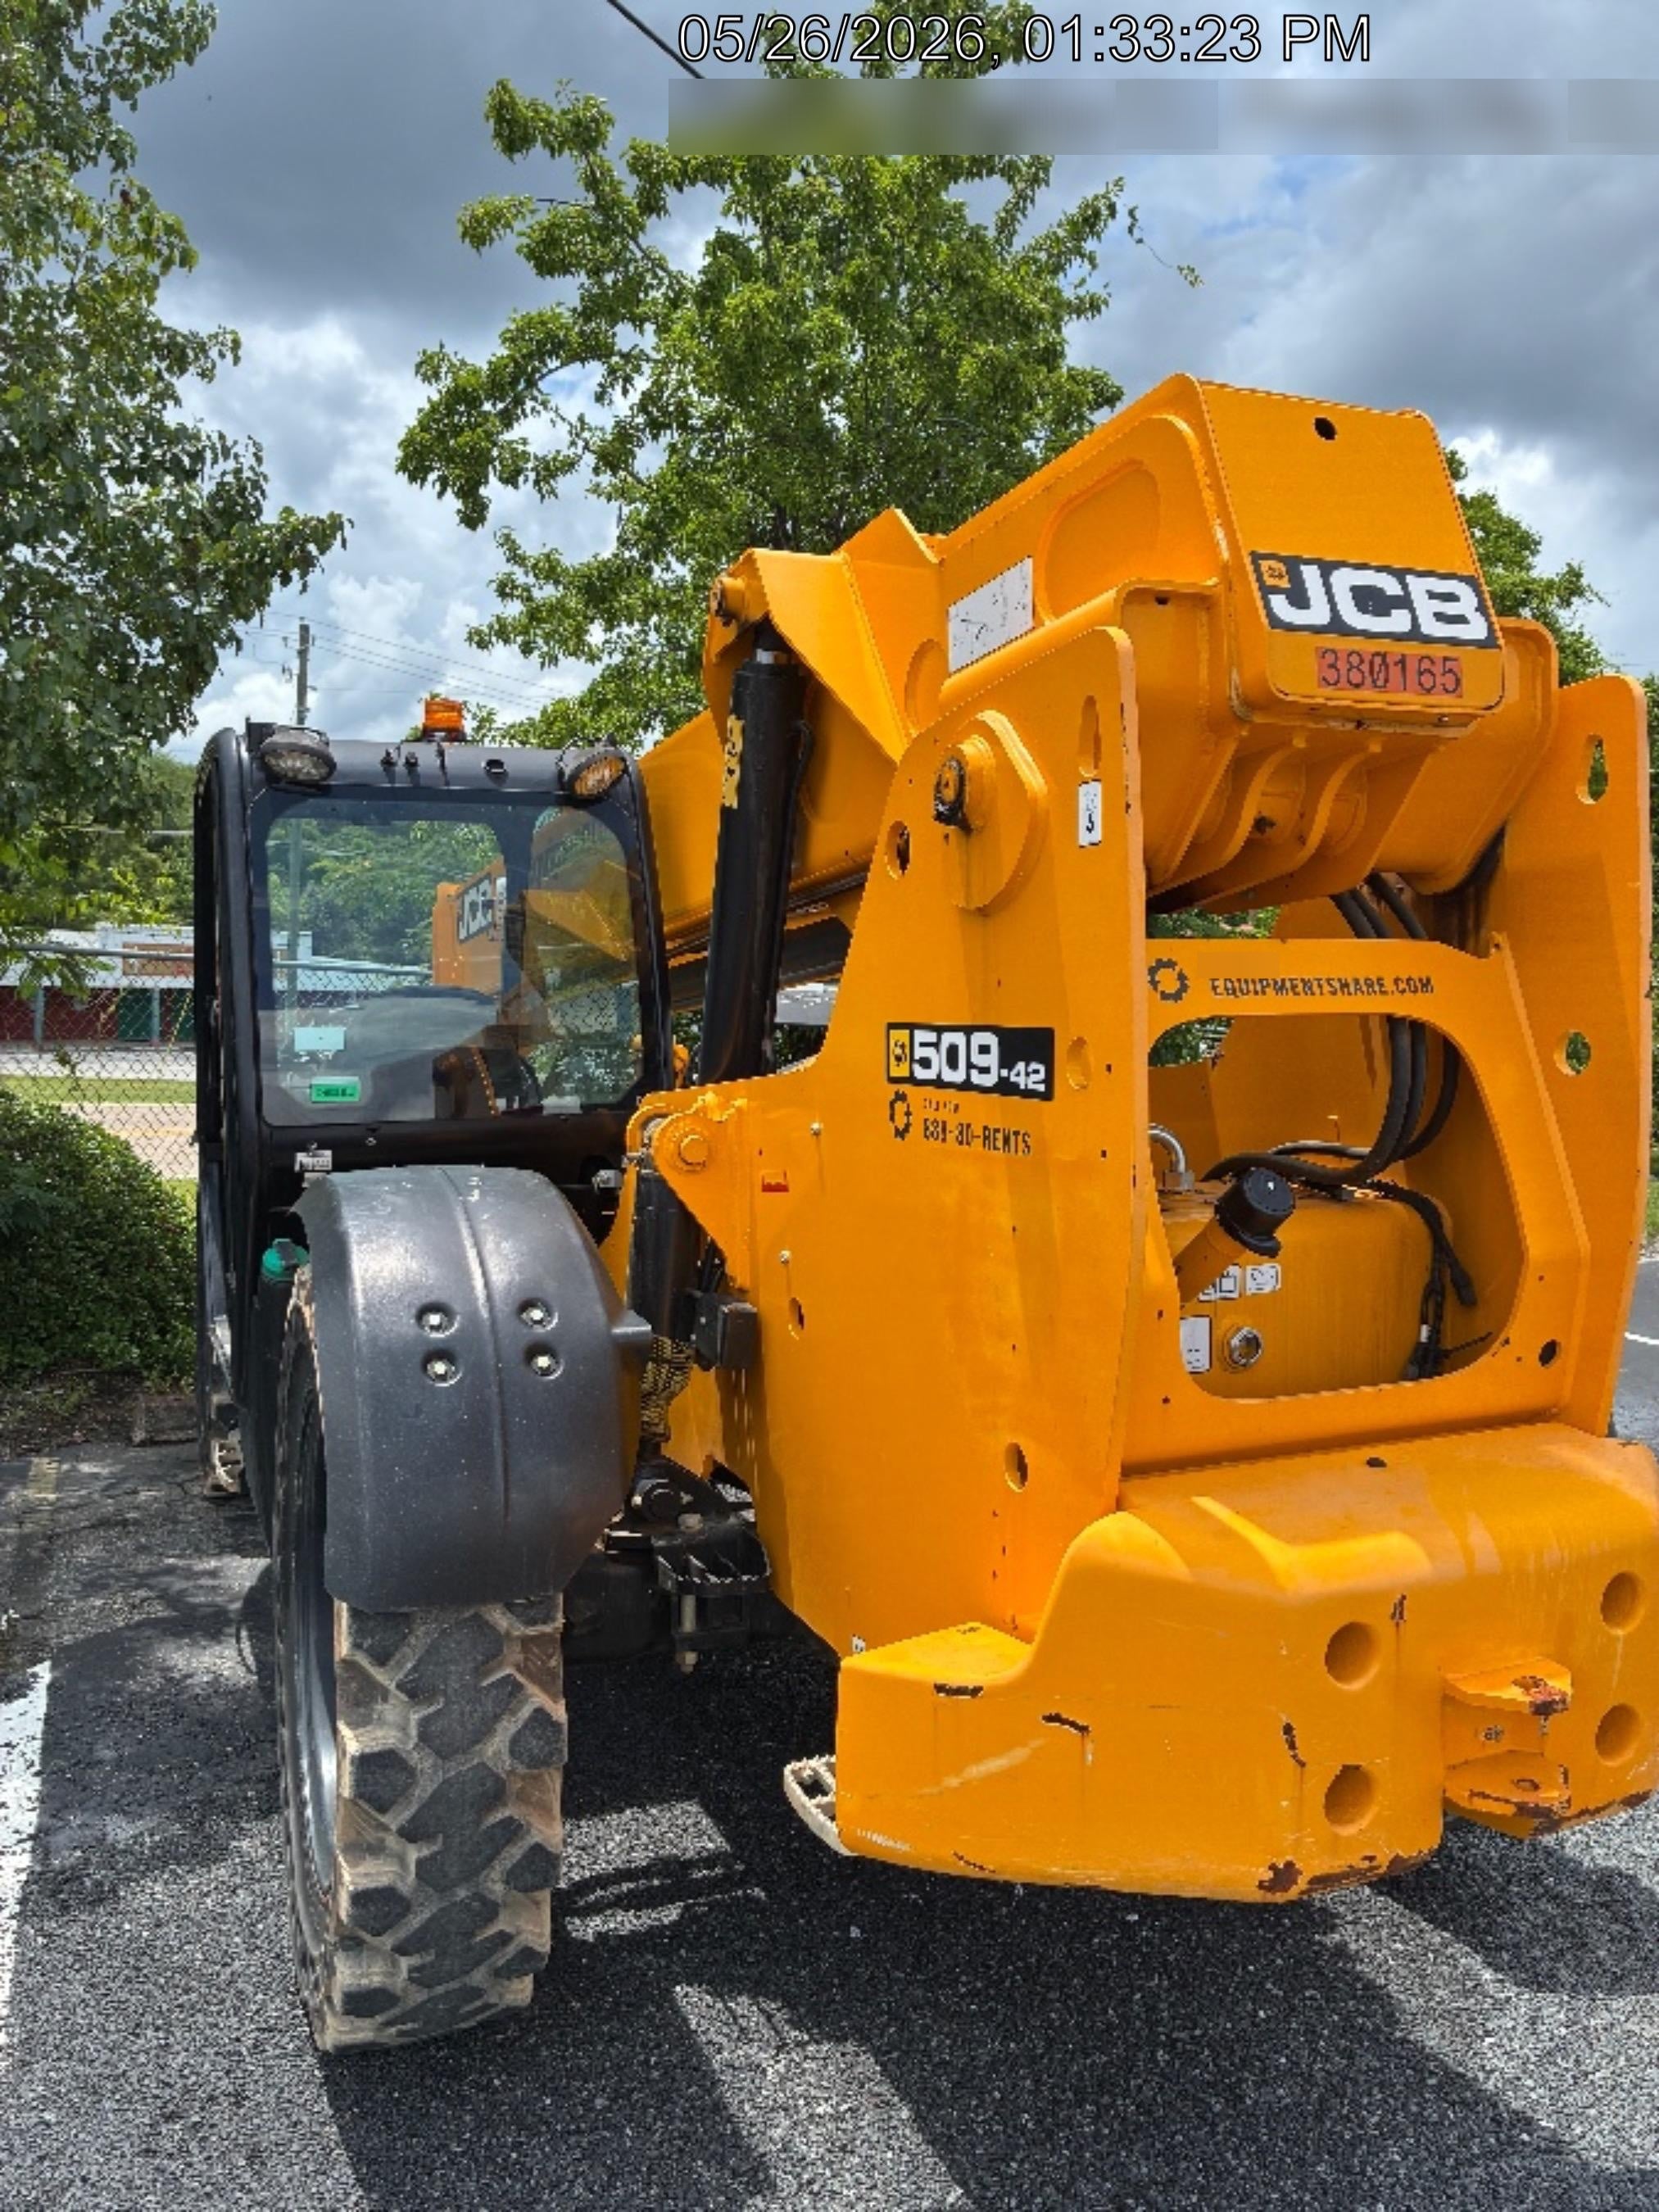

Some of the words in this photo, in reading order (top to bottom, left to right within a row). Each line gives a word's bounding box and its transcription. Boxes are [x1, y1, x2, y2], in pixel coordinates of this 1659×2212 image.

[1267, 564, 1489, 640] JCB
[1321, 648, 1462, 694] 380165
[1209, 976, 1434, 997] EQUIPMENTSHARE.COM
